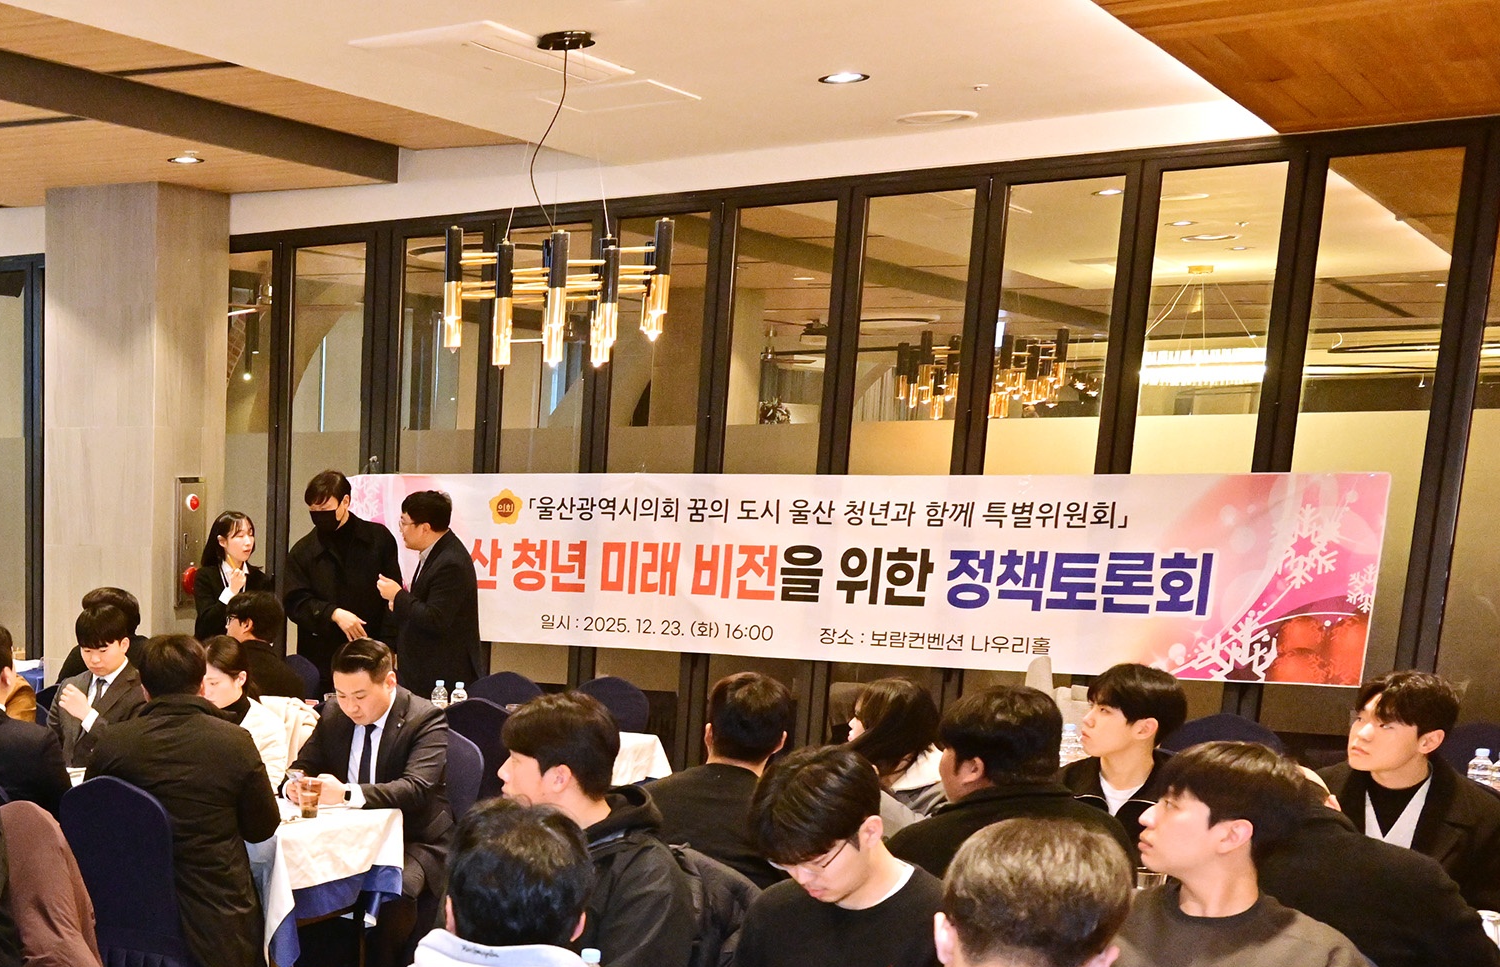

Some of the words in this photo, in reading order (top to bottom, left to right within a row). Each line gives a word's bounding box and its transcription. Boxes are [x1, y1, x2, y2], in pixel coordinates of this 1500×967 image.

[497, 503, 514, 513] 의회
[528, 496, 680, 522] 「울산광역시의회
[687, 498, 730, 523] 꿈의
[737, 499, 780, 524] 도시
[788, 499, 836, 525] 울산
[843, 500, 916, 527] 청년과
[925, 501, 976, 528] 함께
[982, 501, 1128, 529] 특별위원회」
[471, 538, 503, 590] 산
[512, 538, 587, 593] 청년
[600, 541, 681, 596] 미래
[690, 543, 823, 603] 비전을
[836, 547, 934, 607] 위한
[947, 549, 1214, 616] 정책토론회
[540, 614, 571, 631] 일시
[583, 616, 630, 633] 2025.
[636, 618, 656, 634] 12.
[661, 620, 685, 637] 23.
[690, 621, 719, 638] (화)
[724, 623, 774, 641] 16:00
[819, 627, 854, 645] 장소
[870, 630, 964, 651] 보람컨벤션
[971, 635, 1051, 656] 나우리홀
